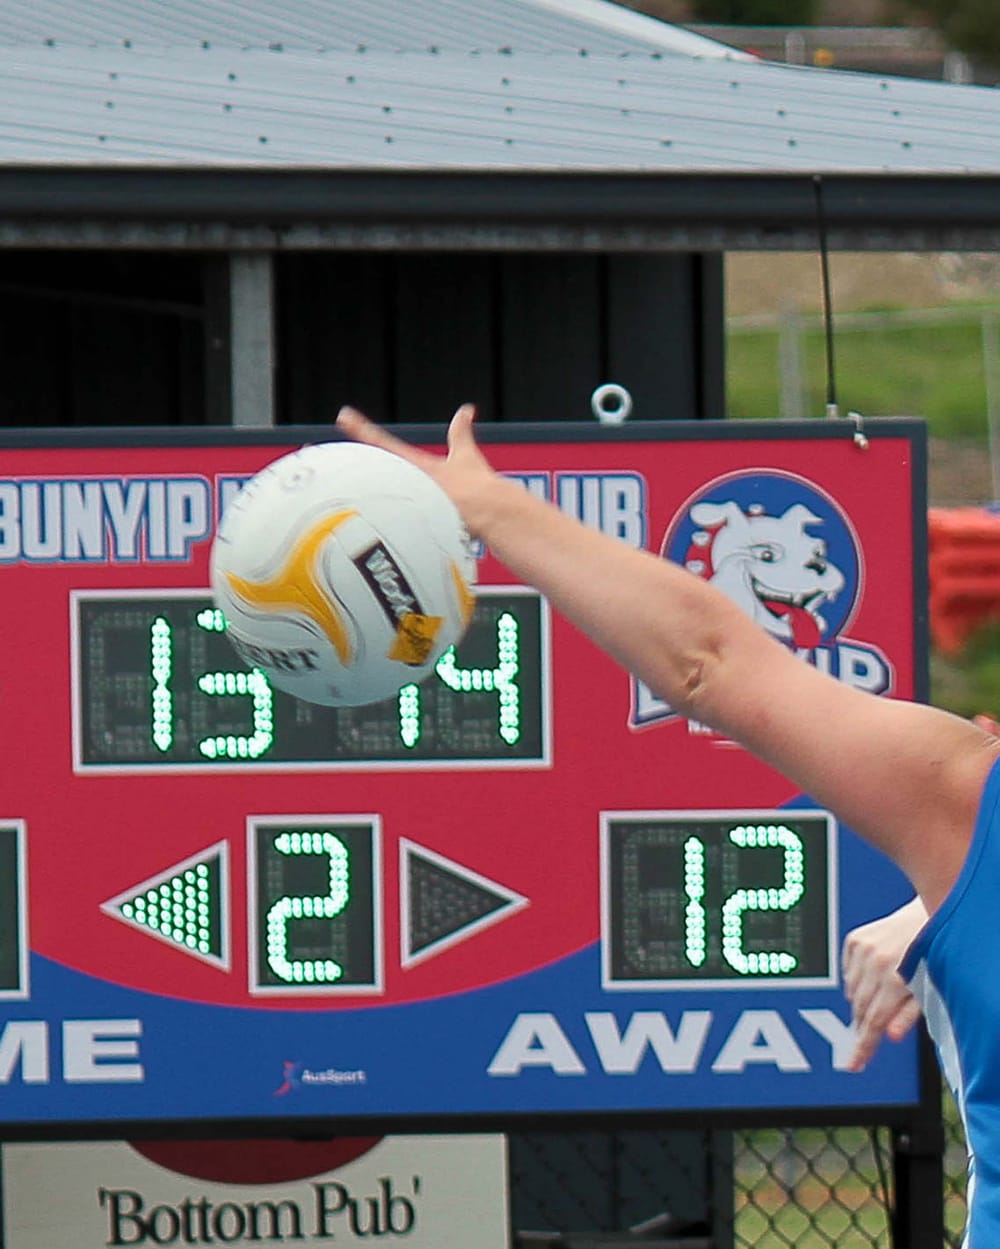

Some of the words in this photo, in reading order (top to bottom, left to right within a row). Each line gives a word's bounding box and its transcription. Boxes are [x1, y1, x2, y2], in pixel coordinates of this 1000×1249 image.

[267, 831, 349, 983] 2
[684, 825, 804, 975] 12
[486, 1009, 867, 1077] AWAY
